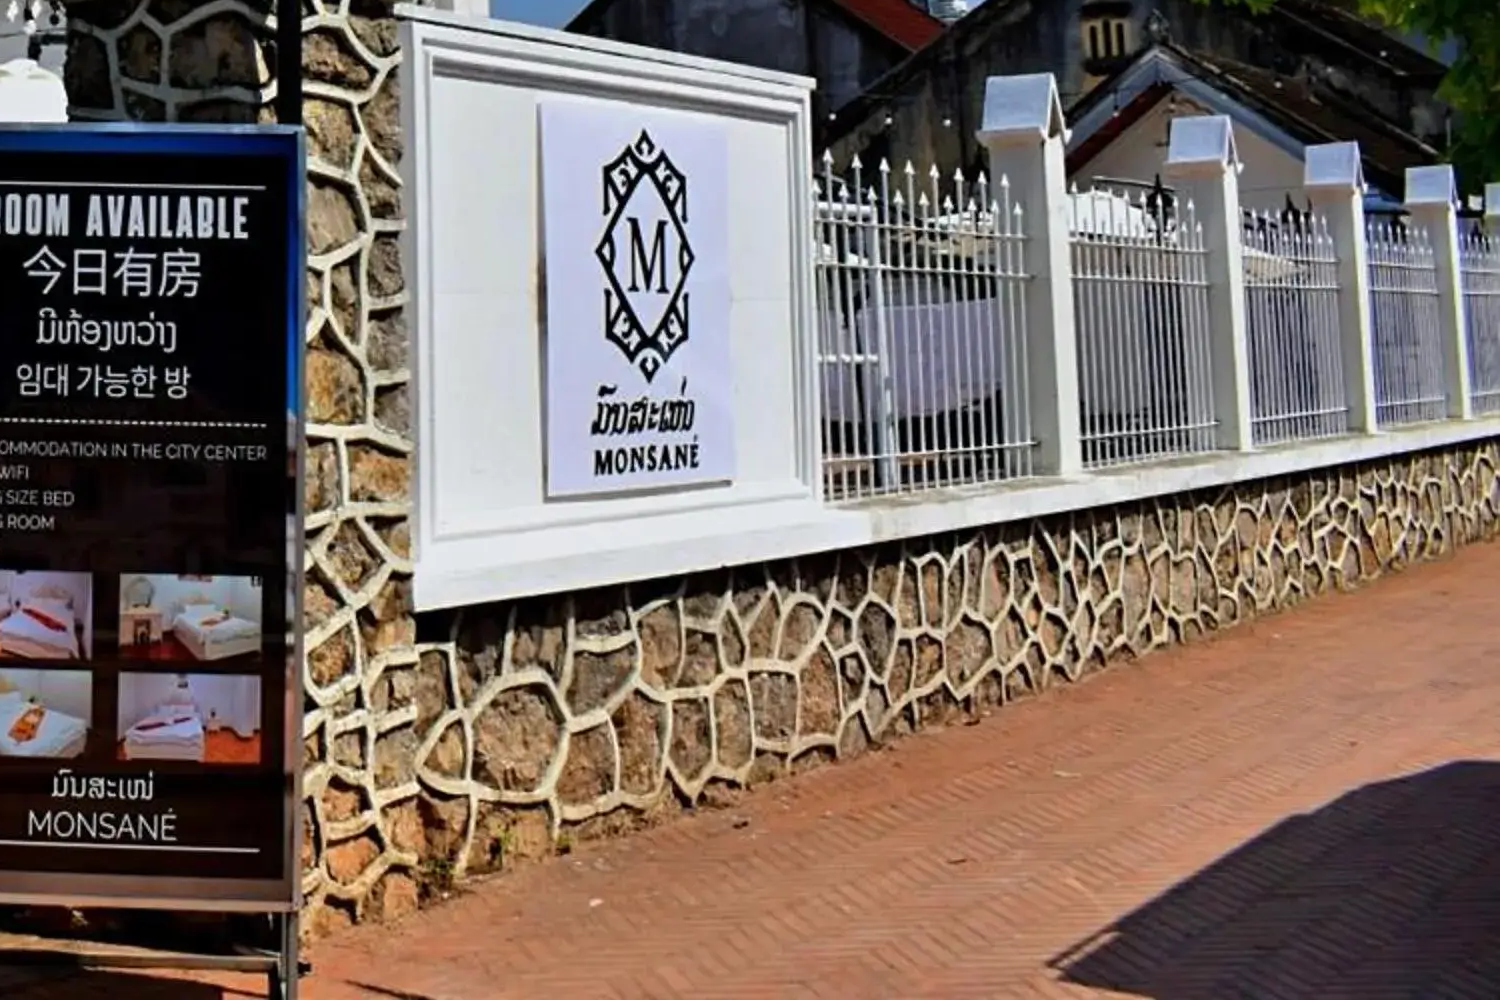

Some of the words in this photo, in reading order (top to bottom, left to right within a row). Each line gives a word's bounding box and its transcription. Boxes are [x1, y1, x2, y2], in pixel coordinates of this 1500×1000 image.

[86, 195, 249, 240] AVAILABLE
[23, 245, 201, 297] 今日有房
[626, 217, 669, 295] M
[16, 363, 69, 397] 임대
[76, 364, 158, 398] 가능한
[164, 365, 191, 399] 방
[111, 443, 127, 457] IN
[132, 443, 162, 459] THE
[165, 443, 200, 460] CITY
[203, 444, 267, 461] CENTER
[594, 434, 700, 476] MONSANÉ
[5, 489, 39, 505] SIZE
[43, 491, 75, 507] BED
[7, 514, 55, 531] ROOM
[27, 807, 178, 842] MONSANÉ
